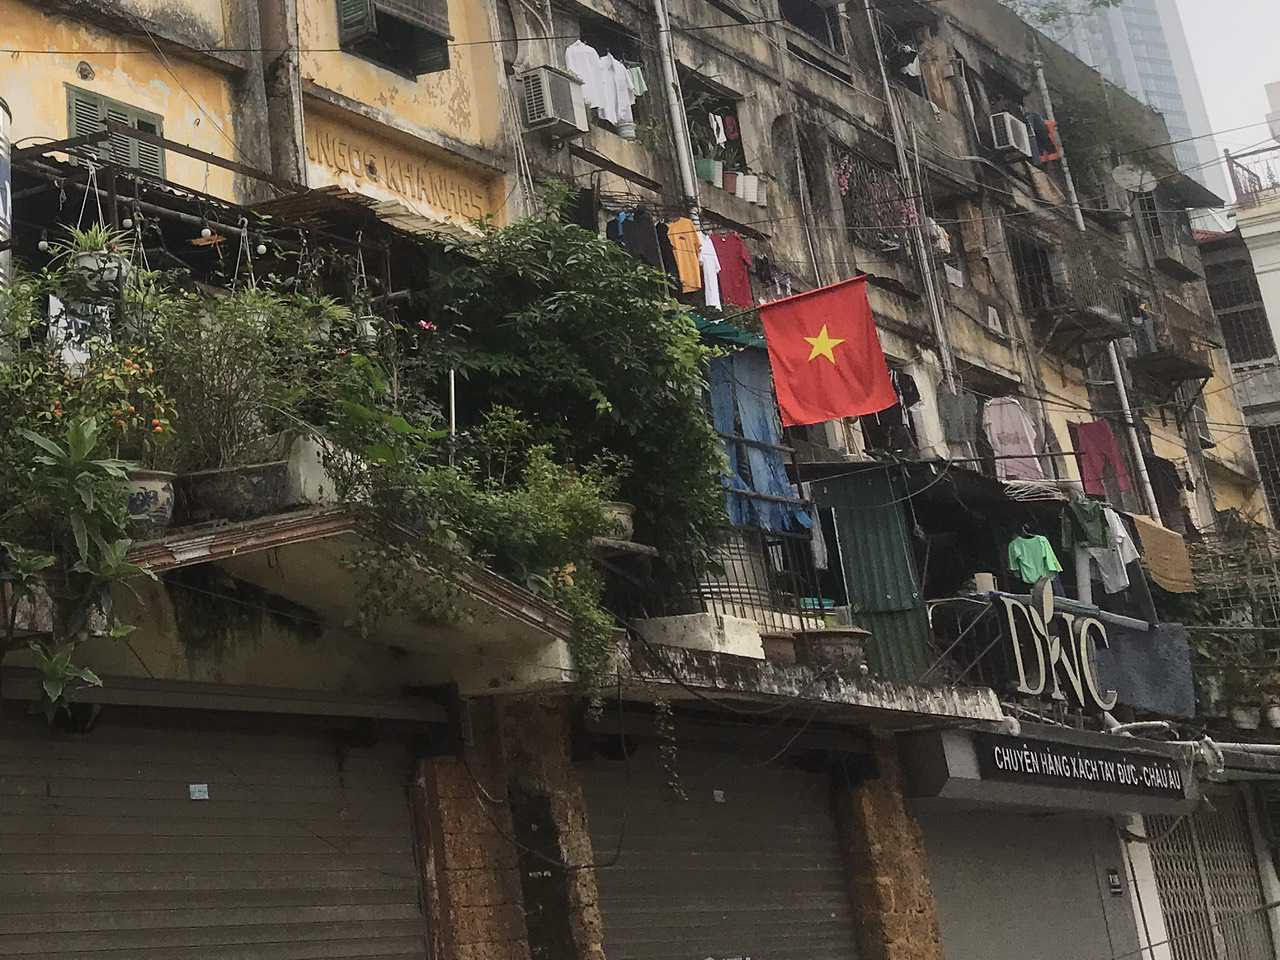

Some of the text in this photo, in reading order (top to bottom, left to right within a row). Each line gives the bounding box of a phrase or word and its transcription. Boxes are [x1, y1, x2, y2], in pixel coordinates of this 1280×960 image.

[994, 744, 1040, 774] CHUYÊN
[1040, 747, 1071, 777] HÀNG
[1070, 752, 1100, 781] XÁCH
[1099, 761, 1117, 783] TAY
